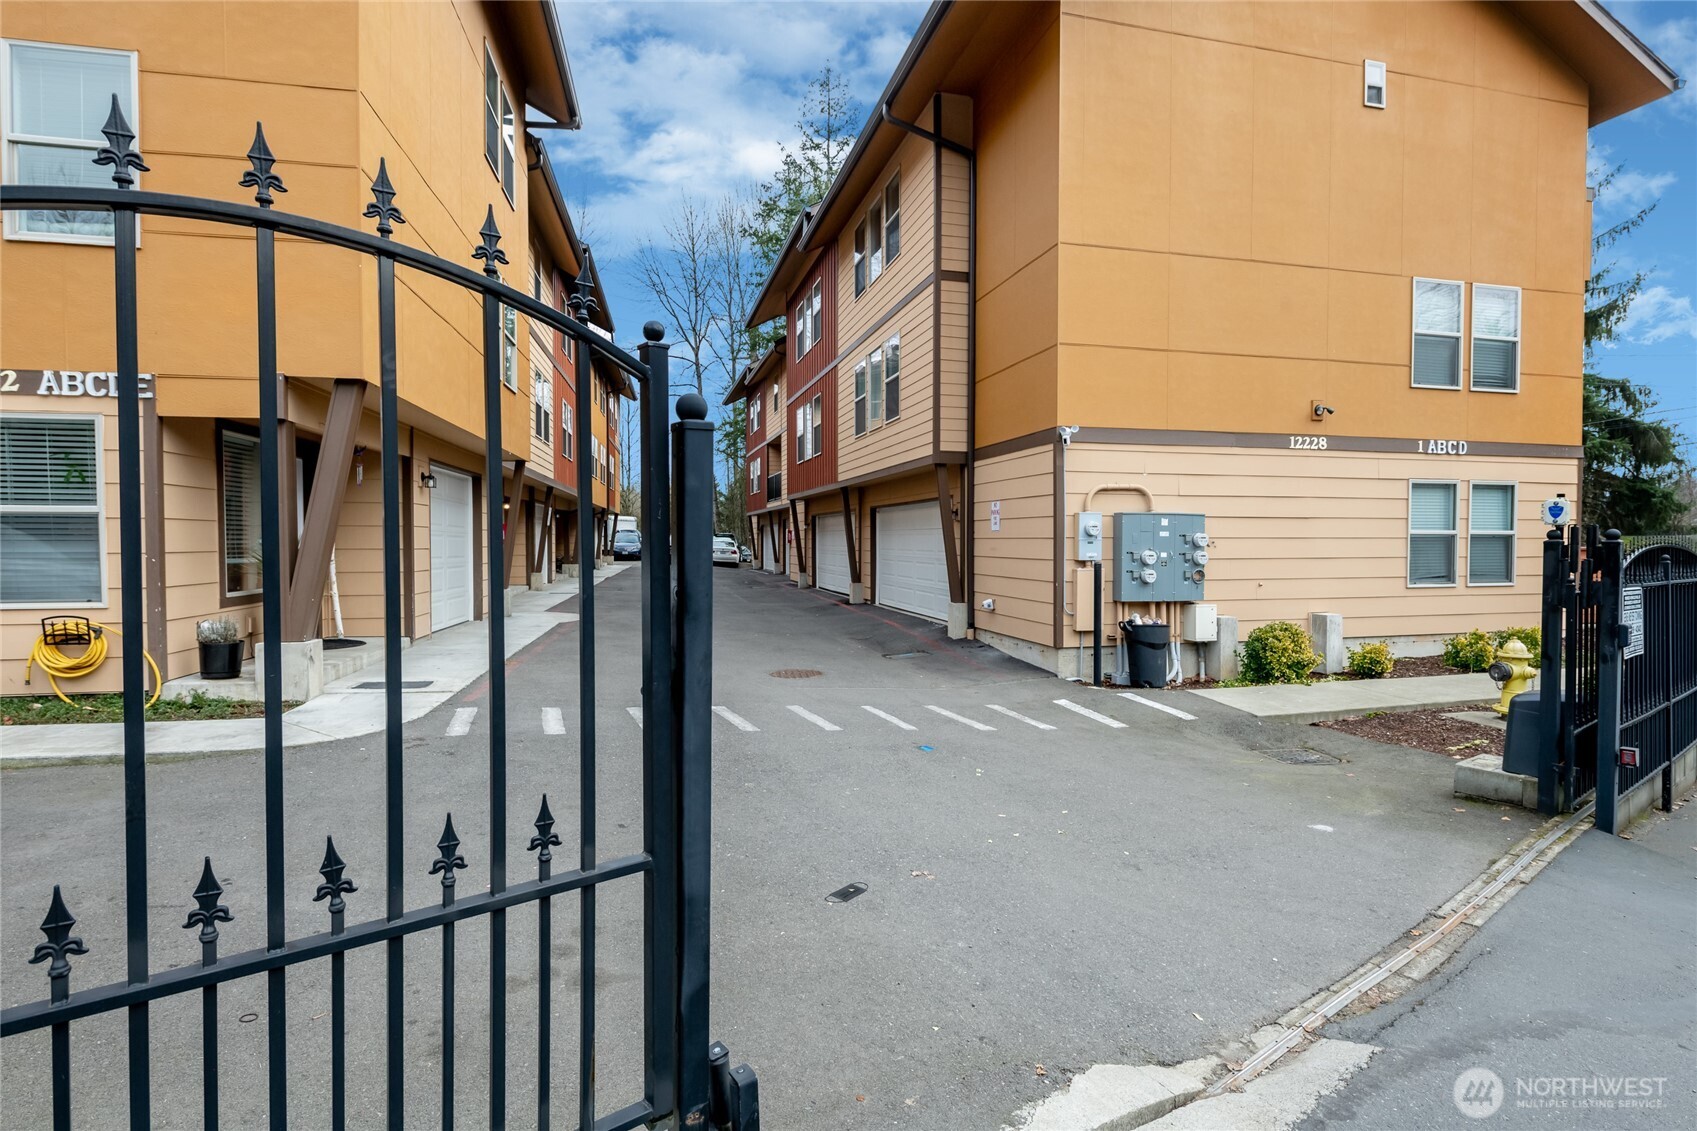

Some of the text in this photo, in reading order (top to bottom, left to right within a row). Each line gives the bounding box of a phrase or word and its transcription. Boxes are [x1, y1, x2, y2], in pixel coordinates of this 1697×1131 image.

[0, 370, 20, 392] 2
[1289, 436, 1327, 450] 12228
[1428, 439, 1468, 454] ABCD
